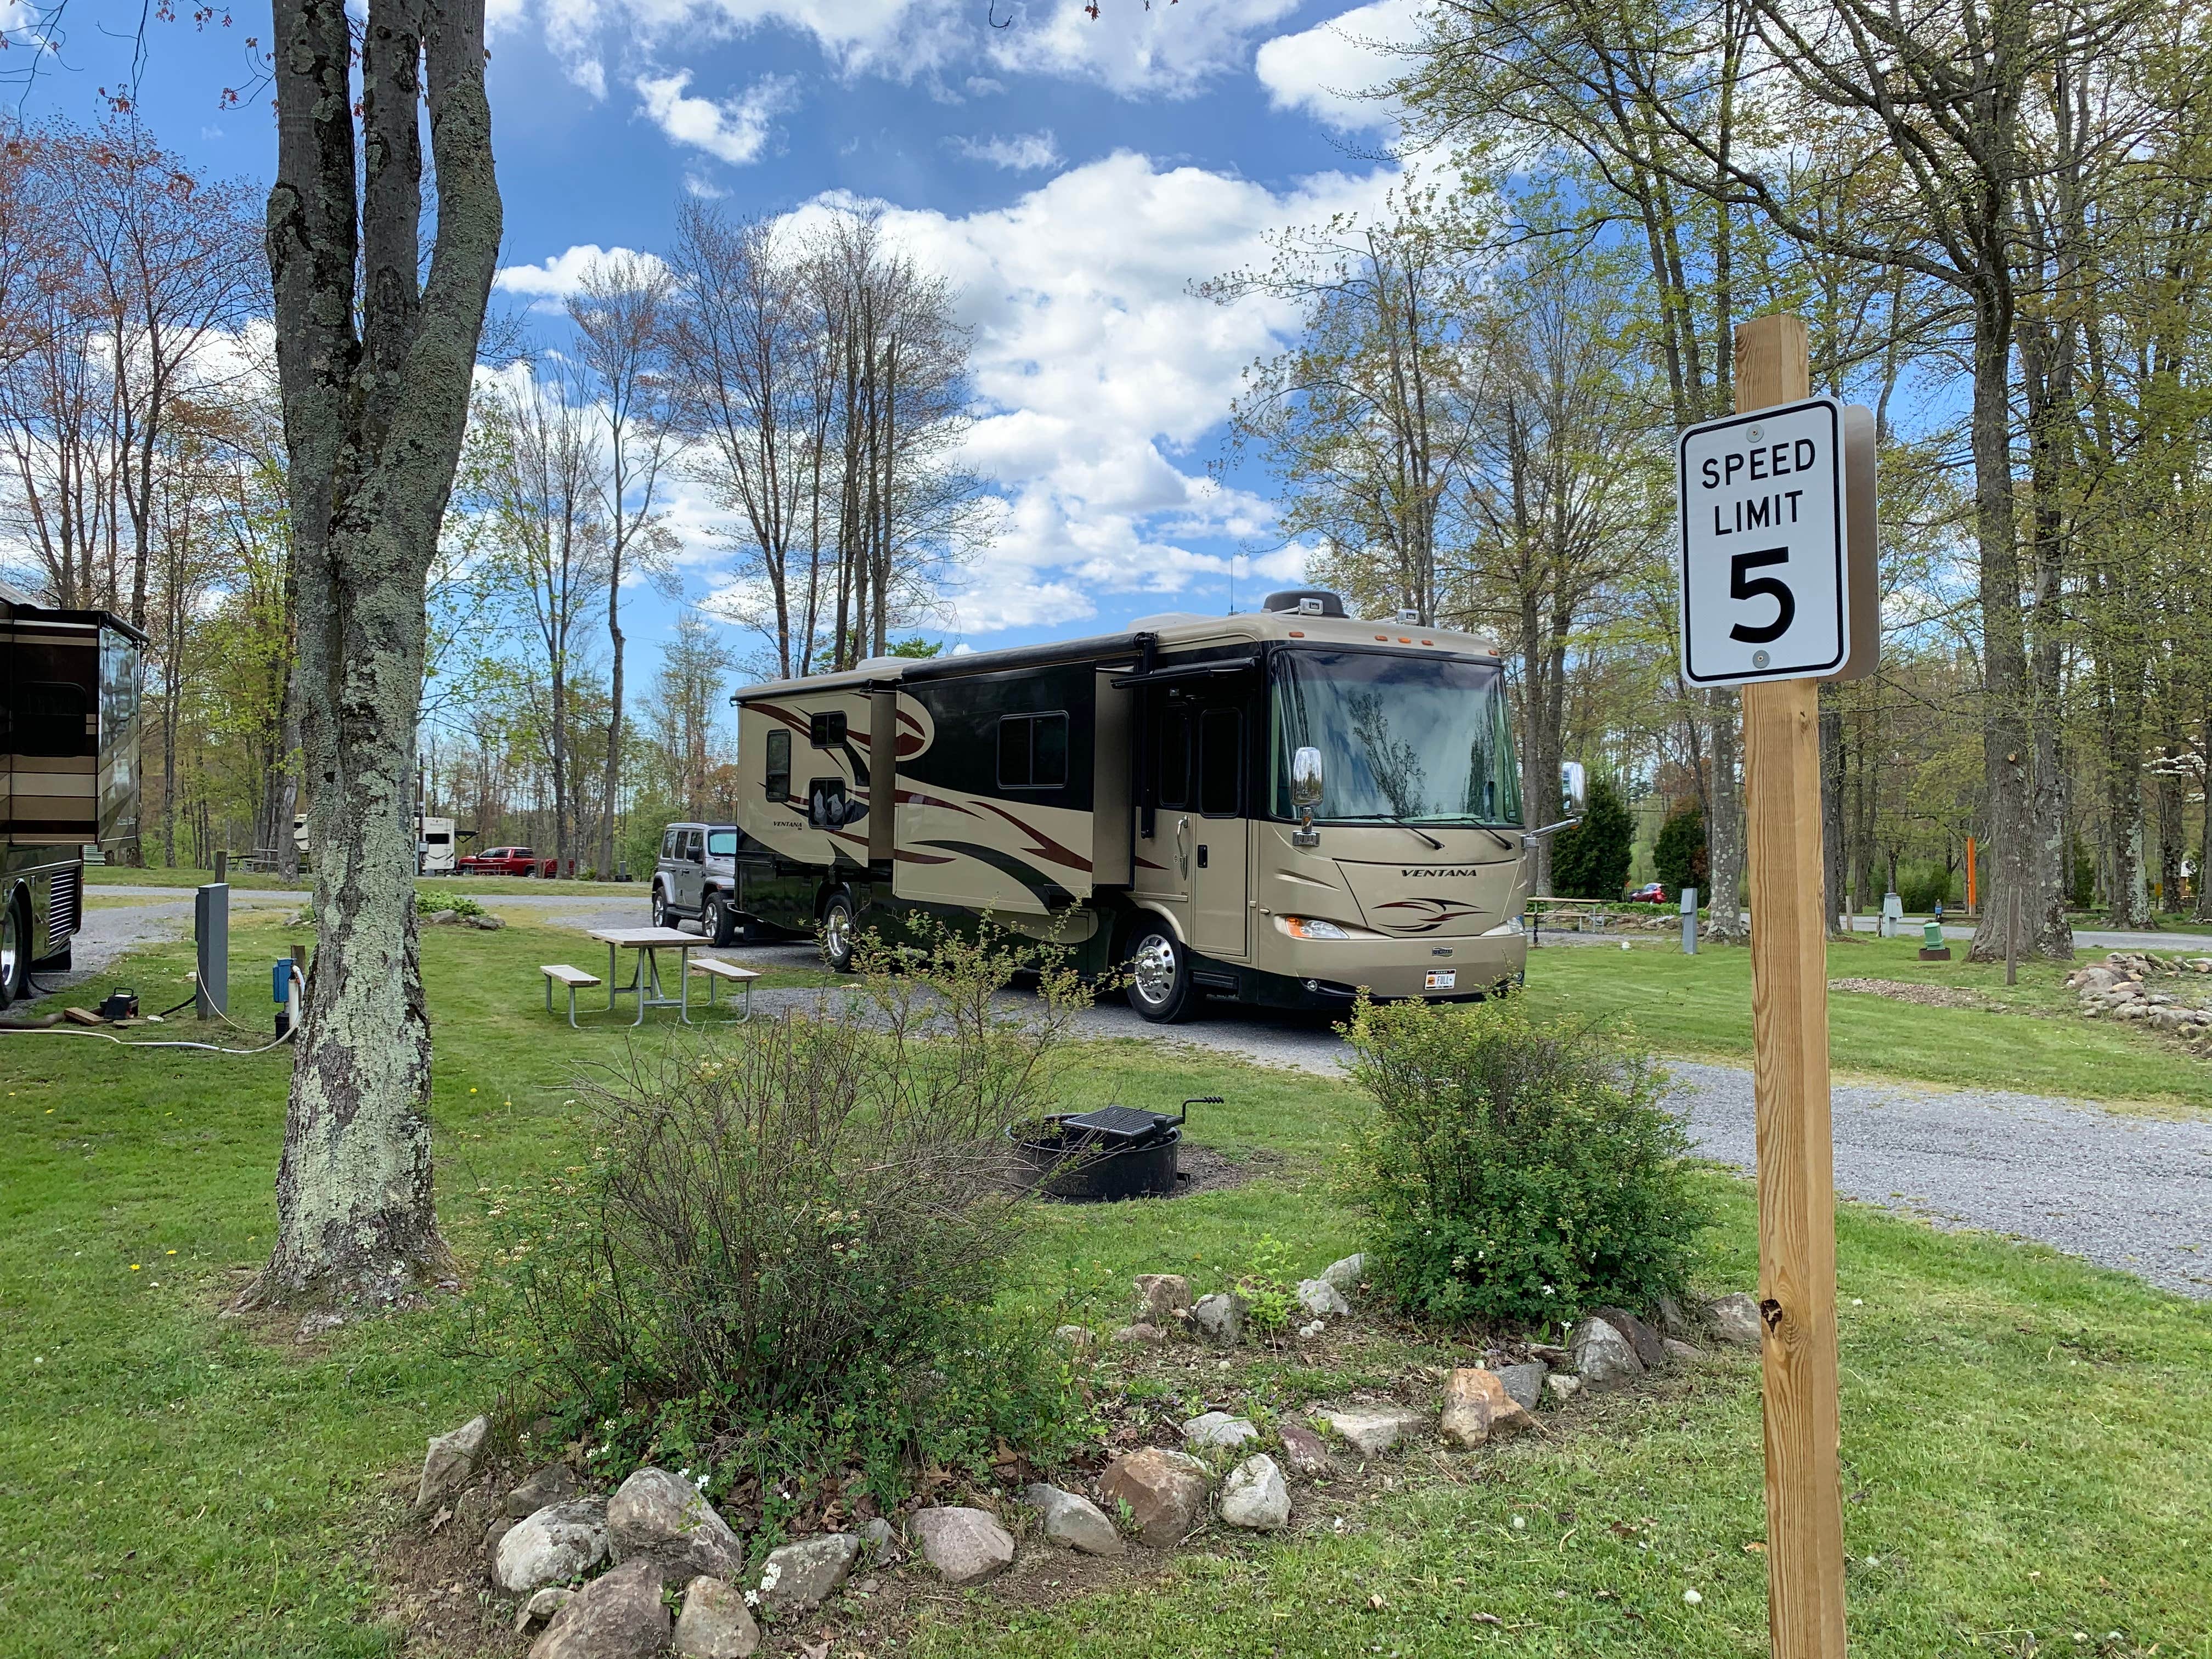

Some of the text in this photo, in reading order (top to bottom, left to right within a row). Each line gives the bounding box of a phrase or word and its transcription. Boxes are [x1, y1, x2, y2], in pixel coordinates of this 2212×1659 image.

[1702, 438, 1816, 489] SPEED
[1714, 489, 1803, 536] LIMIT
[1729, 546, 1796, 644] 5
[1401, 869, 1477, 877] VENTANA
[1437, 975, 1449, 984] FULL
